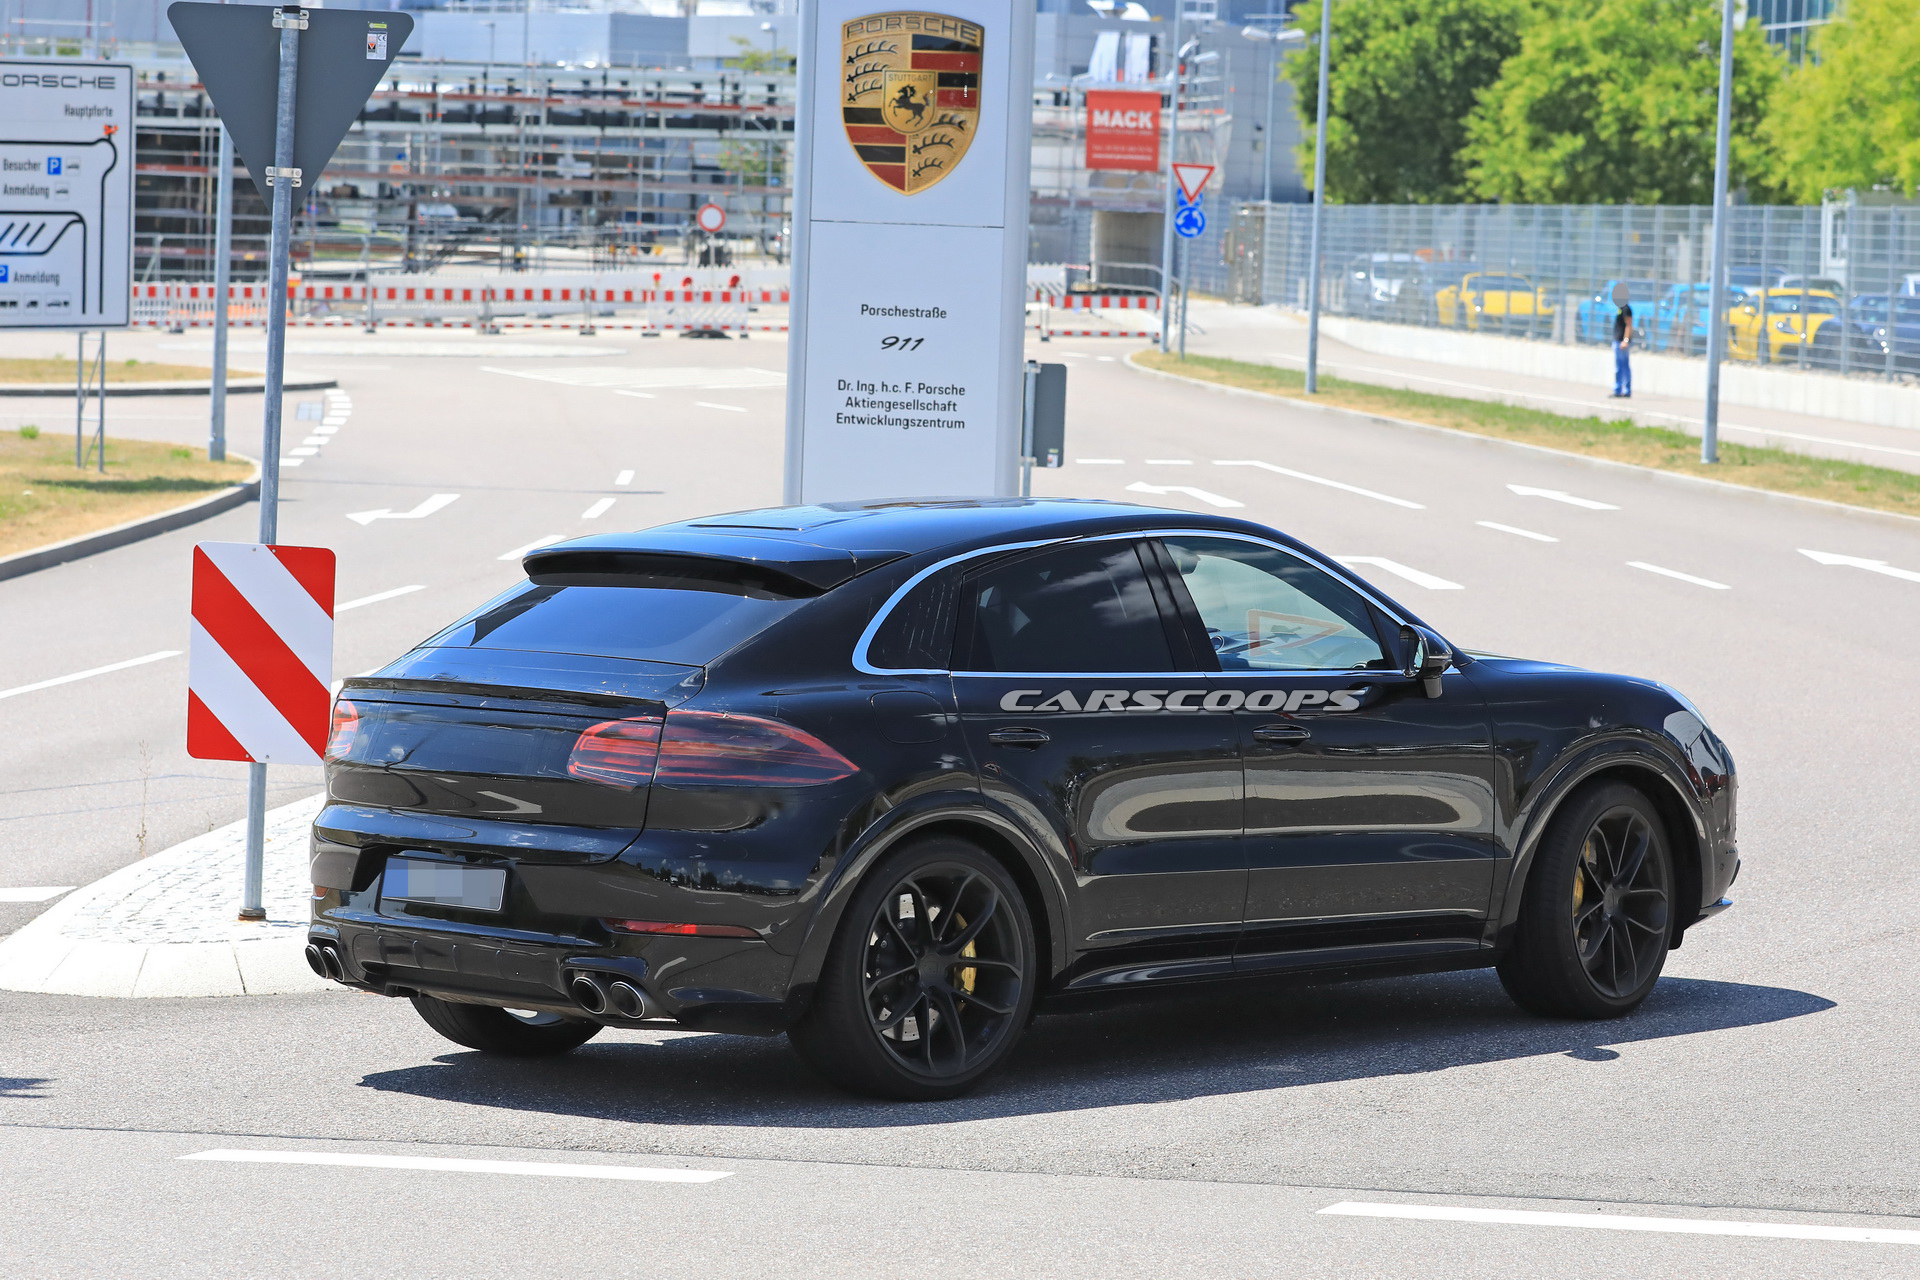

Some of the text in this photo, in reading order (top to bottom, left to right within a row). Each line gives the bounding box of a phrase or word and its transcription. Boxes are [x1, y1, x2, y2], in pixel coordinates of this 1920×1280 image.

[847, 16, 977, 42] PORSCHE
[0, 74, 116, 89] ORSCHE
[888, 73, 933, 83] STUTTGART
[64, 104, 113, 118] Hauptpforte
[1092, 110, 1154, 129] MACK
[3, 159, 41, 172] Besucher
[3, 184, 50, 199] Anmeldung
[14, 272, 60, 286] Anmeldung
[861, 304, 947, 319] Porschestraße
[881, 336, 925, 351] 911
[838, 379, 966, 396] Dr. Ing. h.c. F. Porsche
[845, 396, 957, 412] Aktiengesellschaft
[836, 412, 965, 429] Entwicklungszentrum
